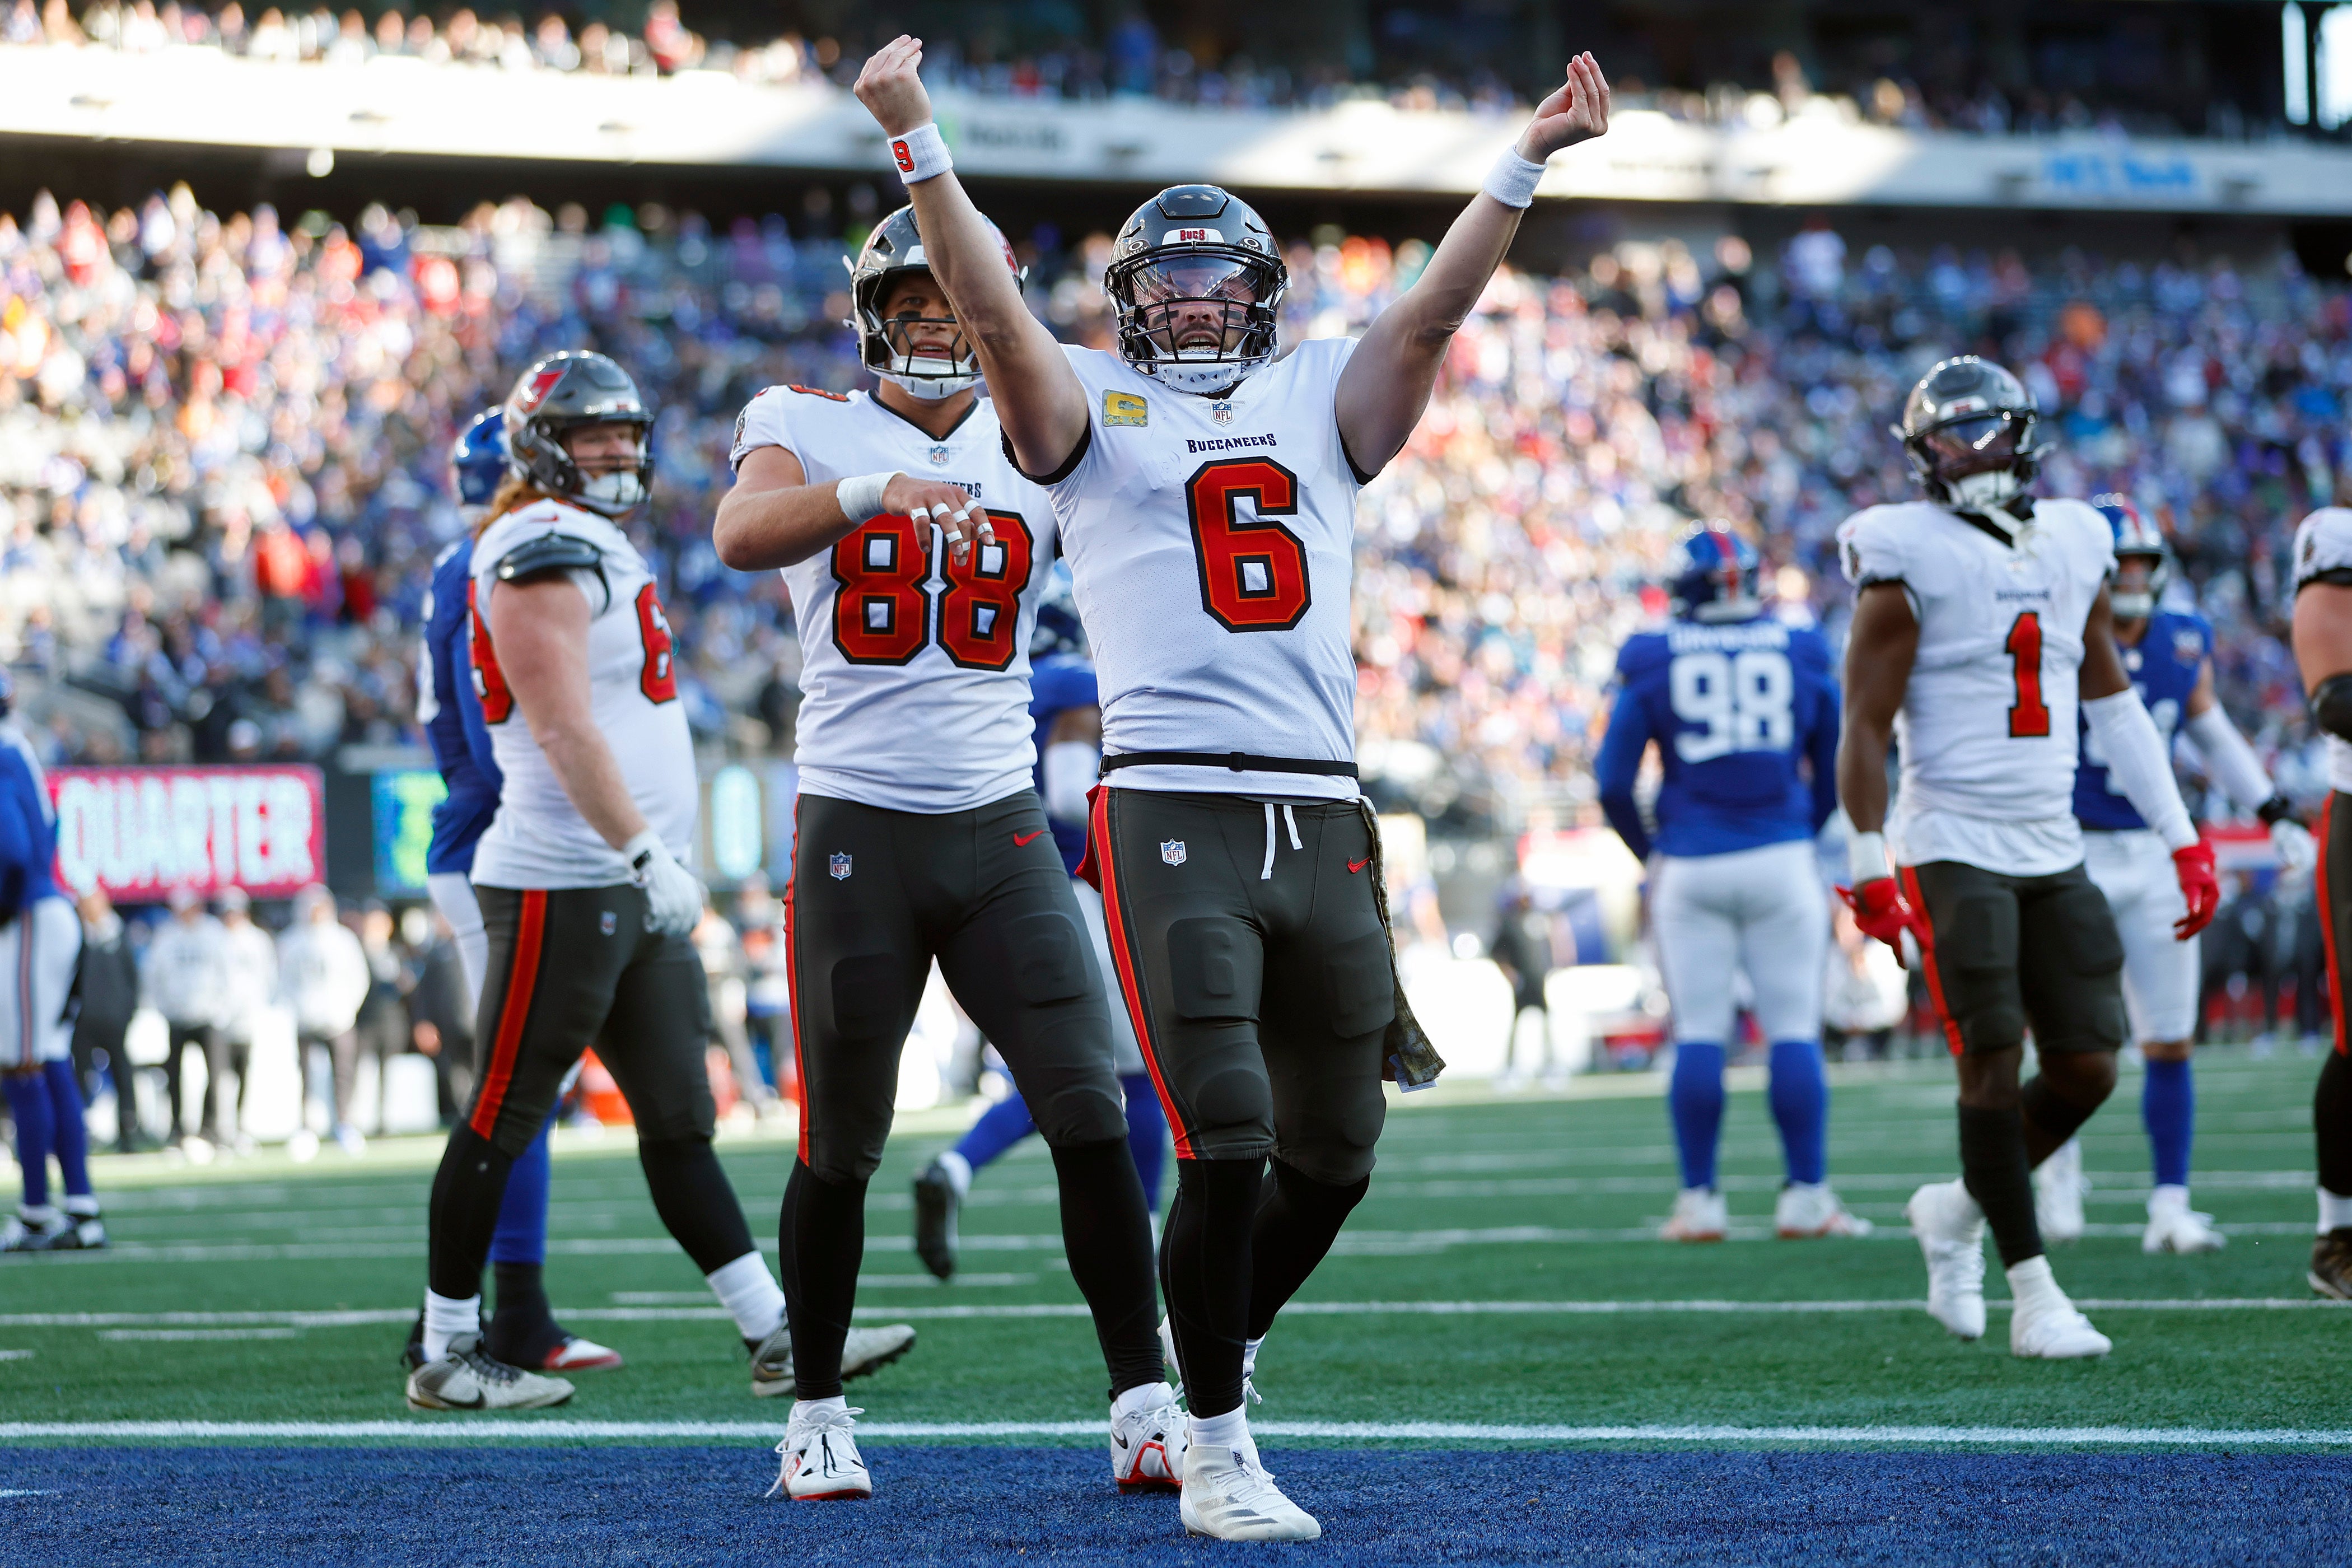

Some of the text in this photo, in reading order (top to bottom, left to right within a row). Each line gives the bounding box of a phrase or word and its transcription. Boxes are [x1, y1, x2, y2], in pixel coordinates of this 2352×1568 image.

[1180, 229, 1206, 241] BUCS
[1107, 393, 1146, 417] C
[1214, 409, 1231, 421] NFL
[1185, 433, 1277, 454] BUCCANEERS
[932, 452, 948, 462] NFL
[1185, 456, 1312, 633] 6
[831, 509, 1034, 671] 88
[2005, 612, 2050, 738] 1
[1669, 651, 1794, 764] 98
[57, 776, 315, 897] QUARTER
[1166, 851, 1183, 861] NFL
[834, 864, 849, 875] NFL
